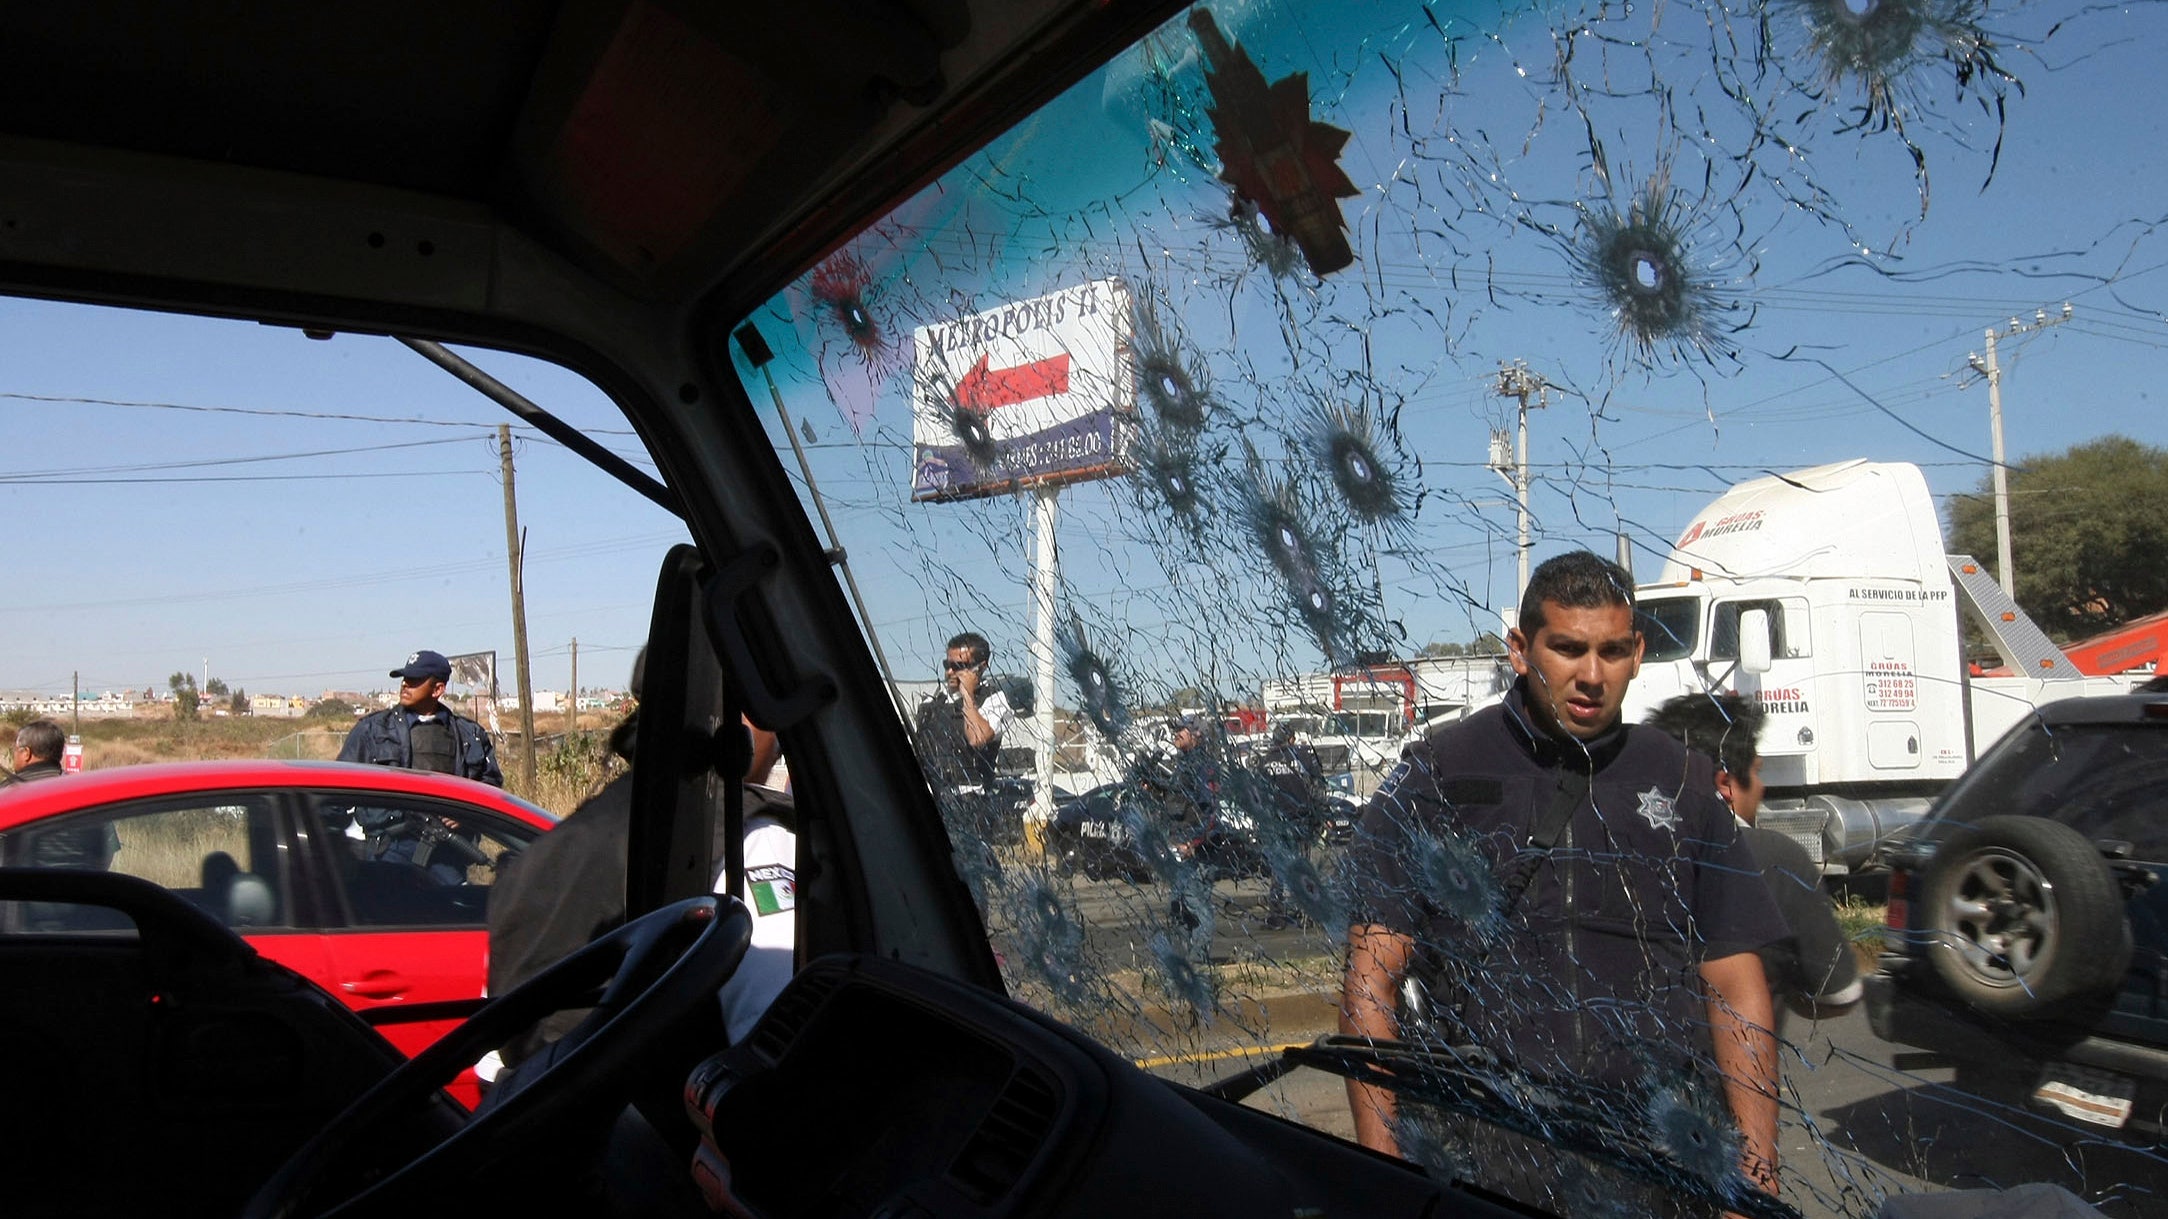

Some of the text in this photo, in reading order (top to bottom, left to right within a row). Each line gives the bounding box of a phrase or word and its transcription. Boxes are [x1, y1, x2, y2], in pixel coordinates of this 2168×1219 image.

[1849, 588, 1948, 601] AL SERVICIO DE LA PFP
[1761, 701, 1809, 714] ORELIA
